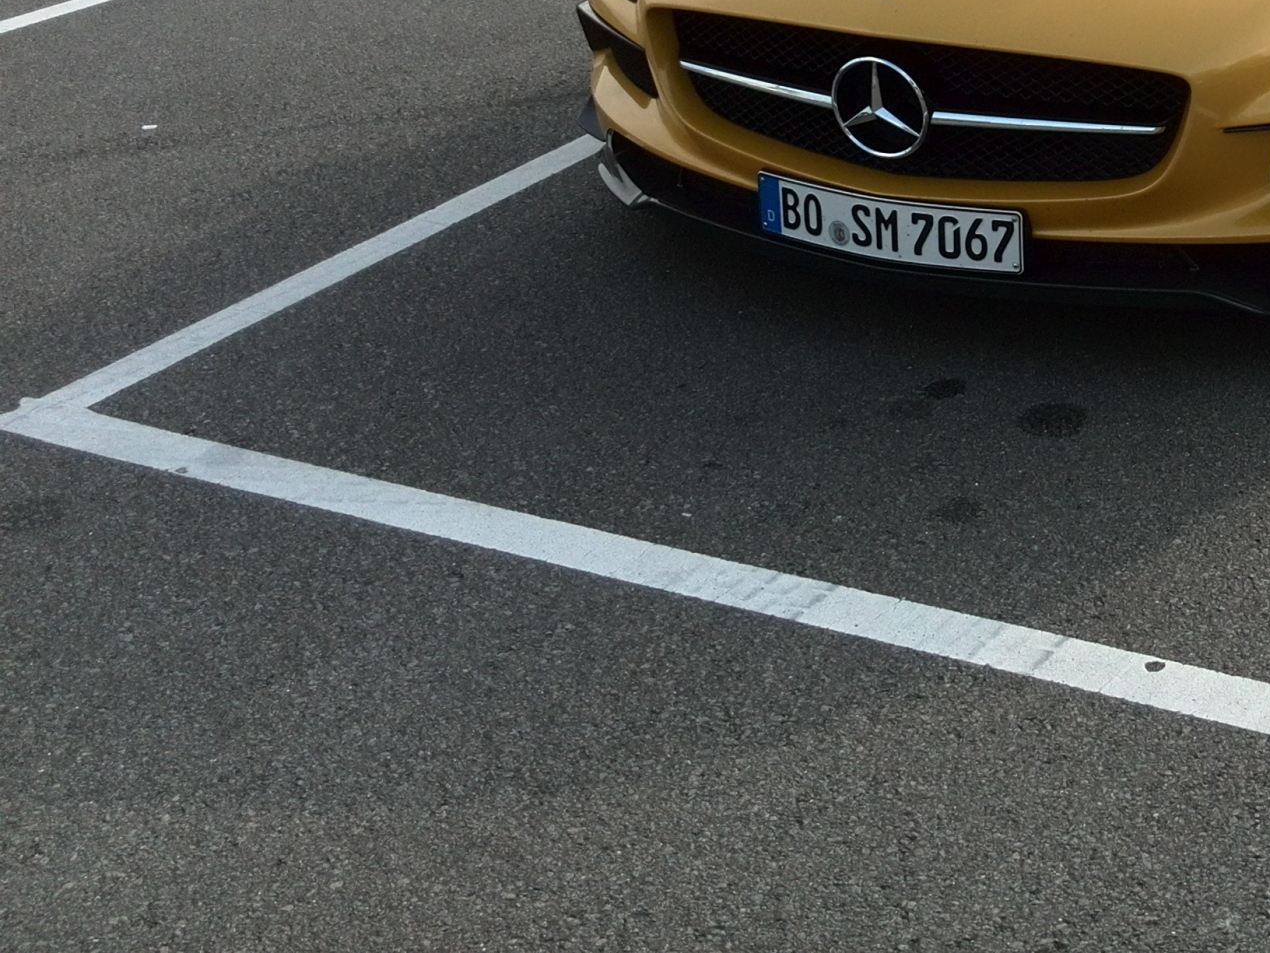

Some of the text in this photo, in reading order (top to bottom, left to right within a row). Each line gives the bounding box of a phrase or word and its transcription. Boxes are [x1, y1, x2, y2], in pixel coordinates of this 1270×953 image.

[781, 186, 1015, 263] BO SM 7067
